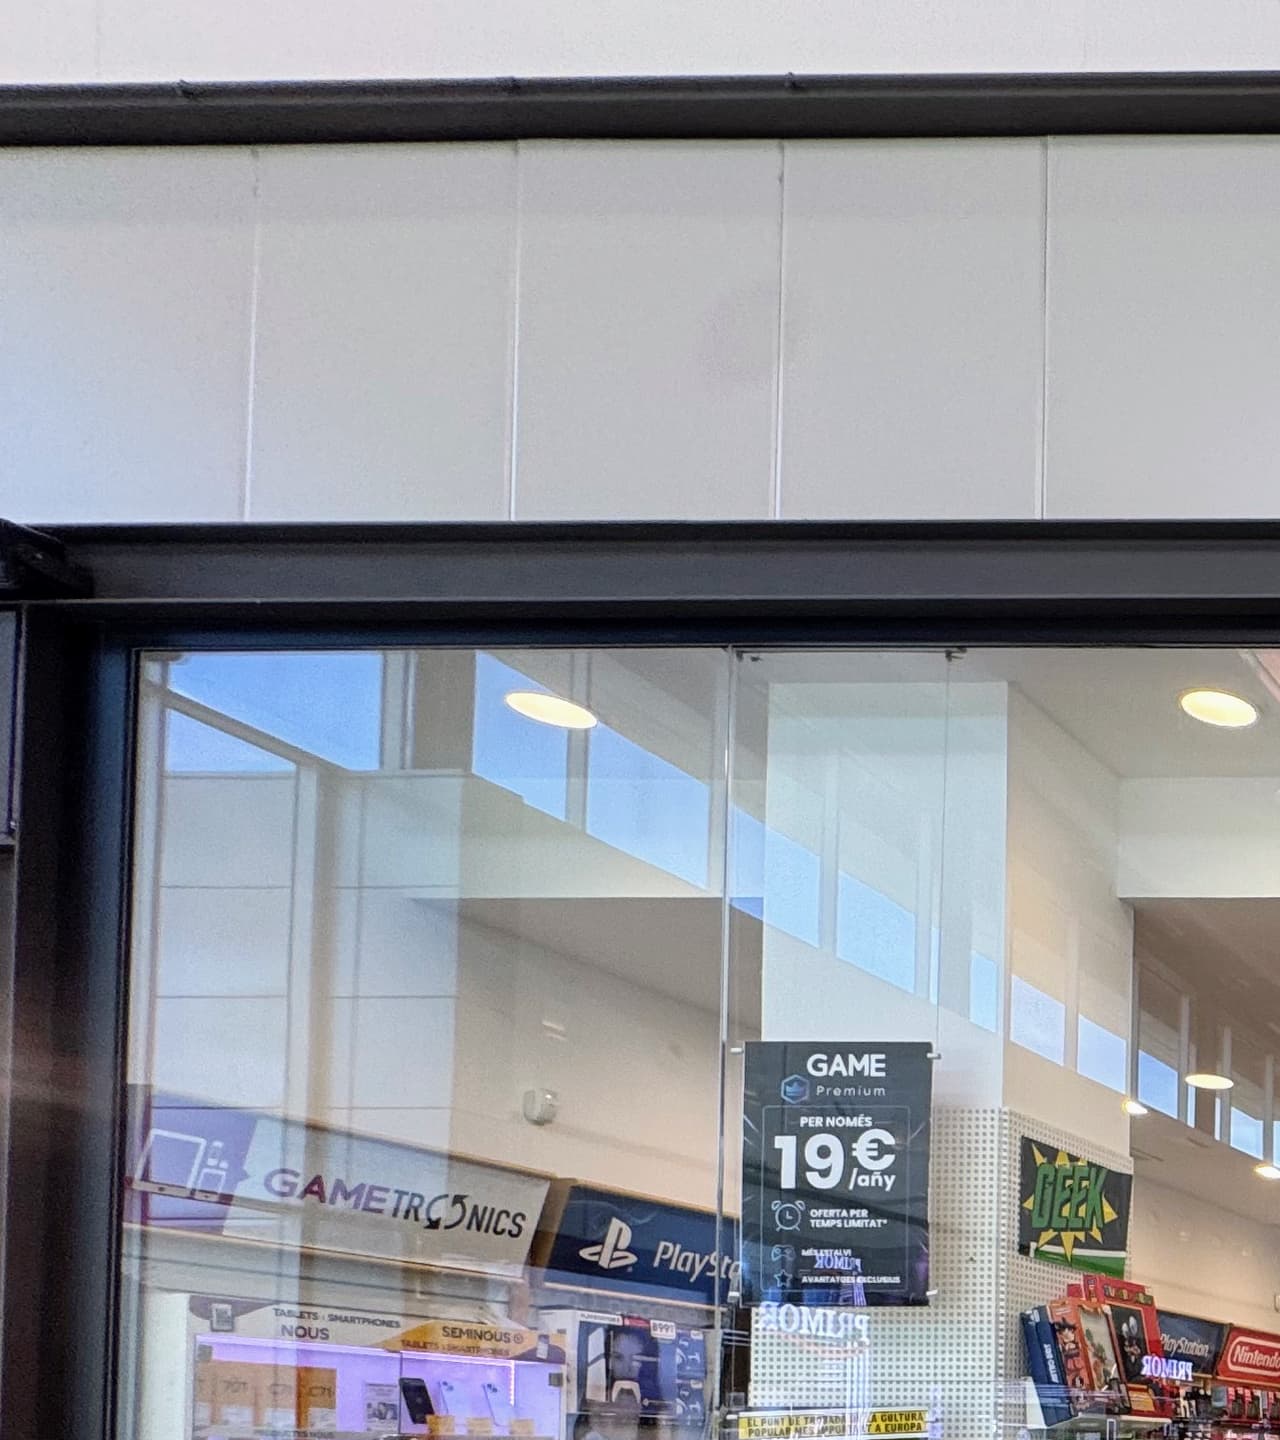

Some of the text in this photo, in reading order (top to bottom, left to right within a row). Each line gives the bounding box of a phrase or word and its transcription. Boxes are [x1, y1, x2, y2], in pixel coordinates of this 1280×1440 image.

[806, 1053, 887, 1078] GAME
[816, 1084, 886, 1097] Premium
[800, 1114, 873, 1128] PER NOMÉS
[264, 1168, 527, 1240] GAMETRONICS
[1030, 1162, 1108, 1231] GEEK
[810, 1208, 869, 1219] OFERTA PER
[810, 1218, 842, 1229] TEMPS
[652, 1238, 741, 1284] PlaySta
[273, 1308, 401, 1329] TABLETS SMARTPHONES
[281, 1325, 330, 1341] NOUS
[441, 1325, 512, 1343] SEMINOUS
[1159, 1333, 1209, 1357] PlayStation
[885, 1422, 923, 1433] EUROPA
